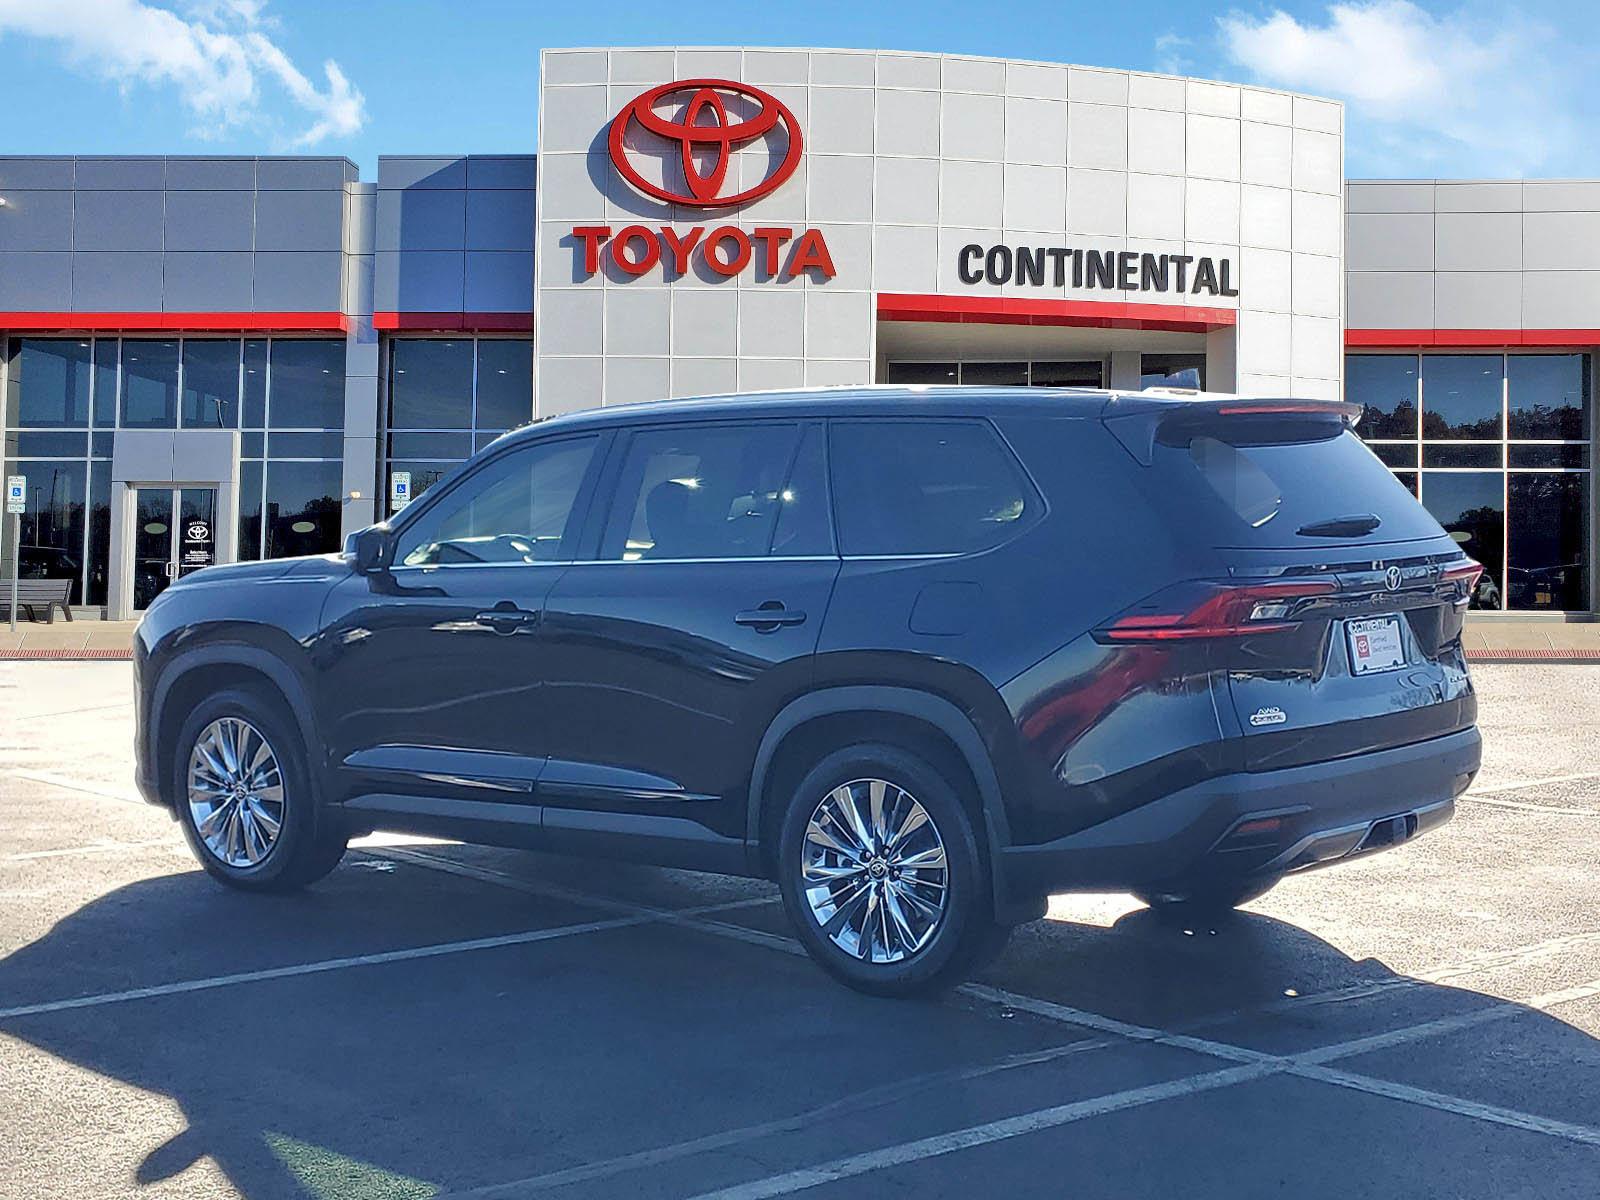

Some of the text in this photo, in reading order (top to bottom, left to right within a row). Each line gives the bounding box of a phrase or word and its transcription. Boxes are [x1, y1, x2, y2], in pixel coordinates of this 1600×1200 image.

[573, 225, 836, 276] TOYOTA
[958, 244, 1238, 296] CONTINENTAL
[1257, 706, 1280, 715] AWD
